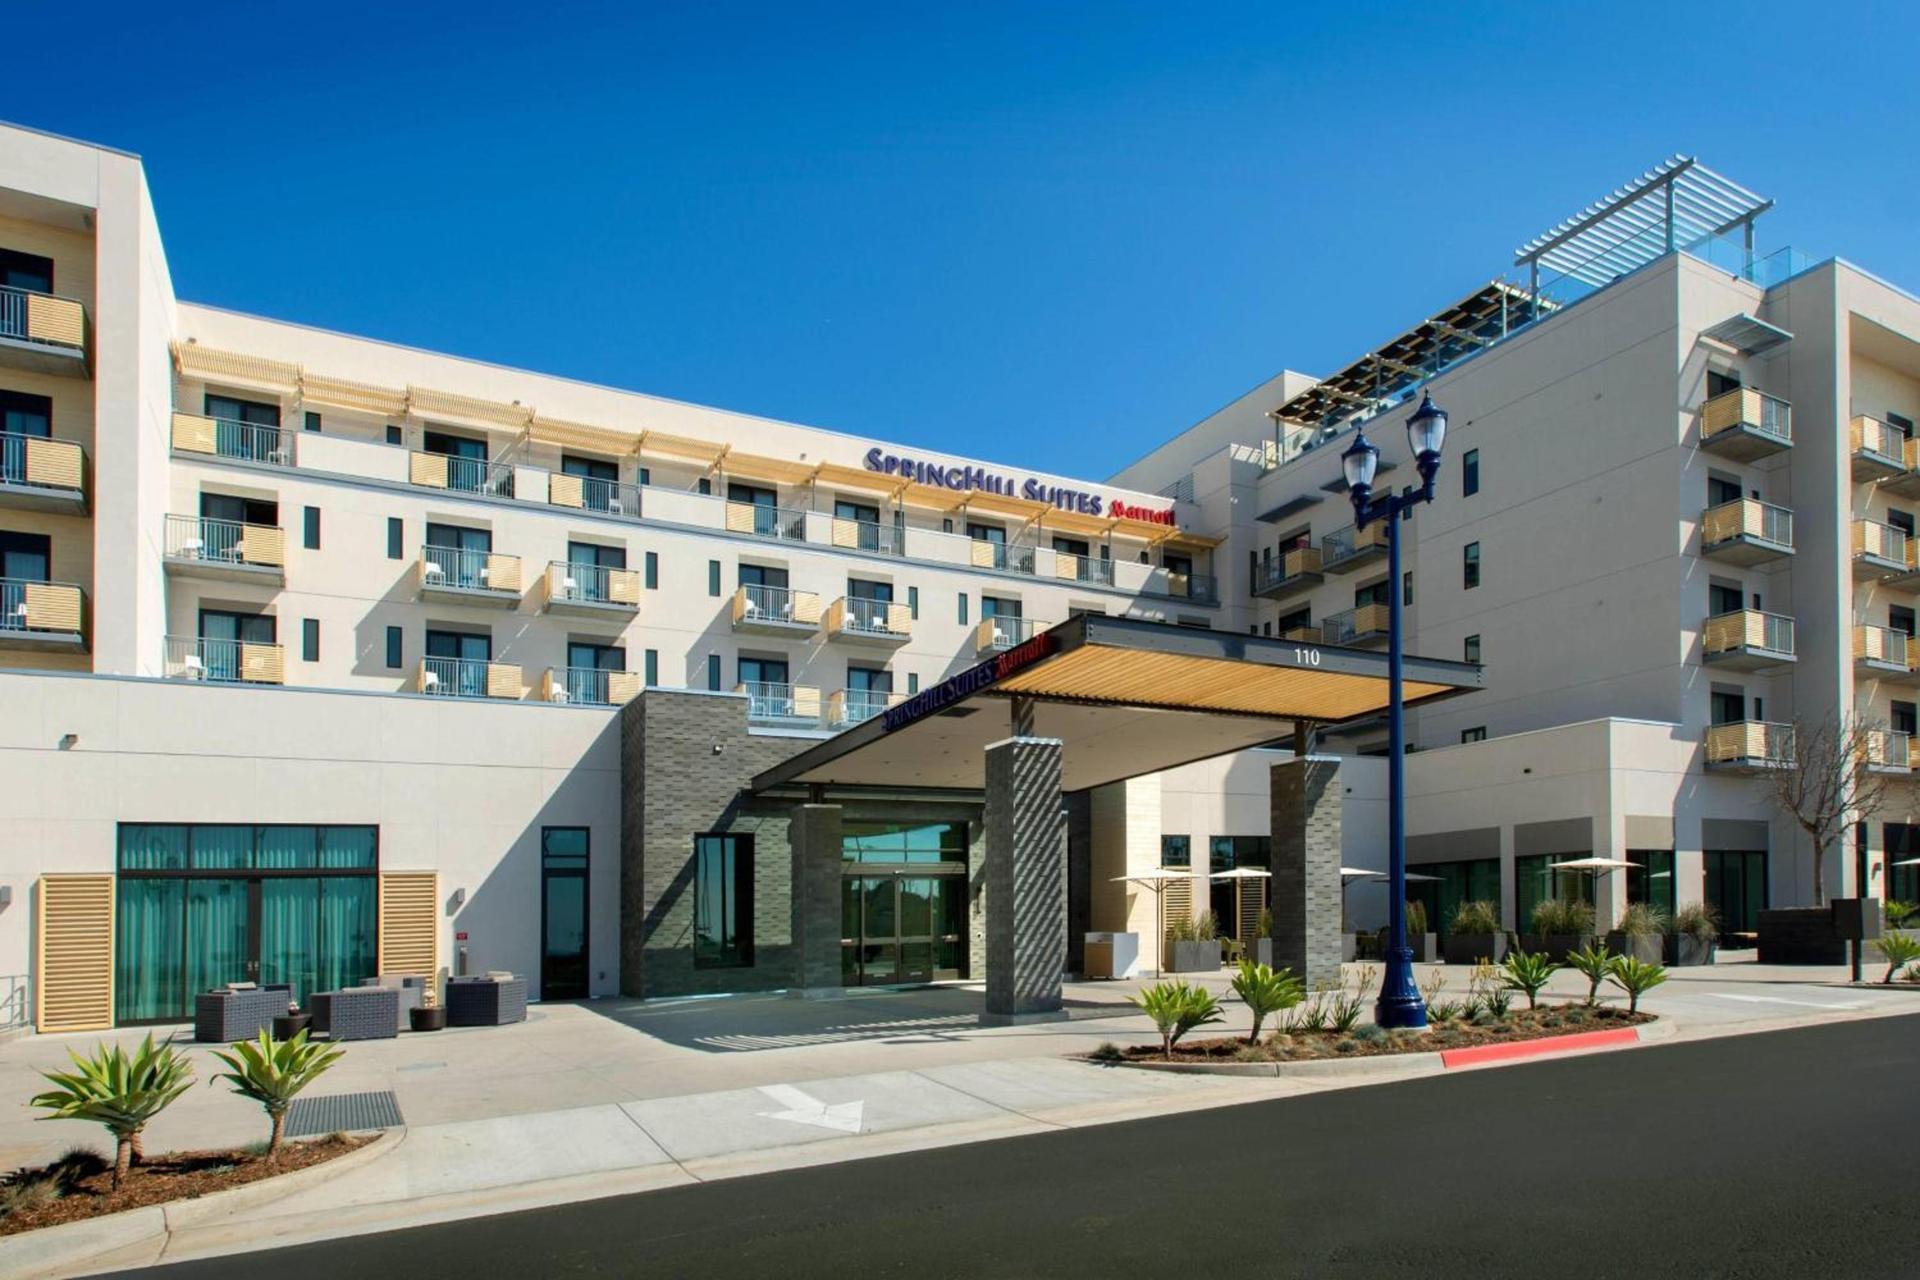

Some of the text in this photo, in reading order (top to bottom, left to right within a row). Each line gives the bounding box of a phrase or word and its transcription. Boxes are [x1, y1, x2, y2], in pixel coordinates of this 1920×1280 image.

[863, 448, 1018, 497] SPRINGHILL
[1021, 478, 1102, 516] SUITES
[1294, 648, 1320, 666] 110
[946, 660, 996, 700] SUITES
